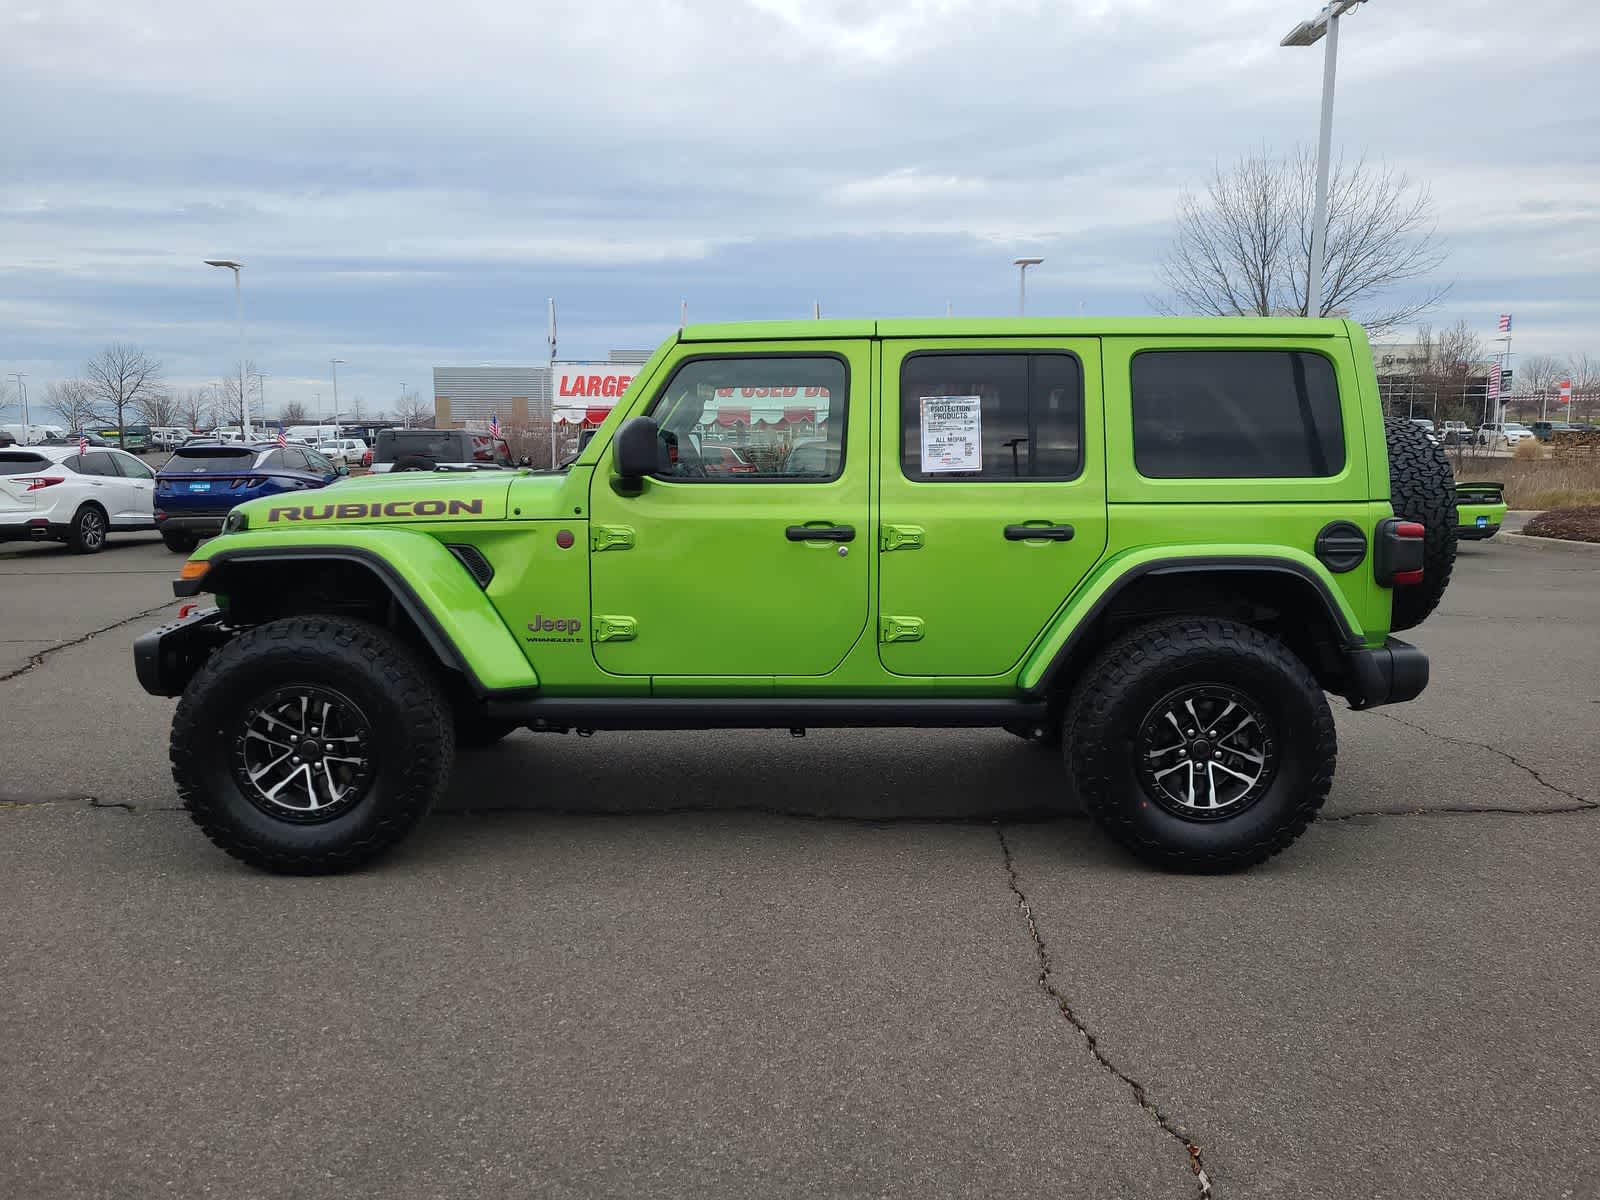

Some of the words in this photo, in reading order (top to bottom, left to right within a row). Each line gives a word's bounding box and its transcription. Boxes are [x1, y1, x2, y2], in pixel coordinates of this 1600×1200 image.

[559, 375, 637, 397] LARGE
[930, 405, 970, 413] PROTECTION
[933, 412, 968, 420] PRODUCTS
[268, 499, 483, 522] RUBICON
[527, 614, 581, 635] Jeep
